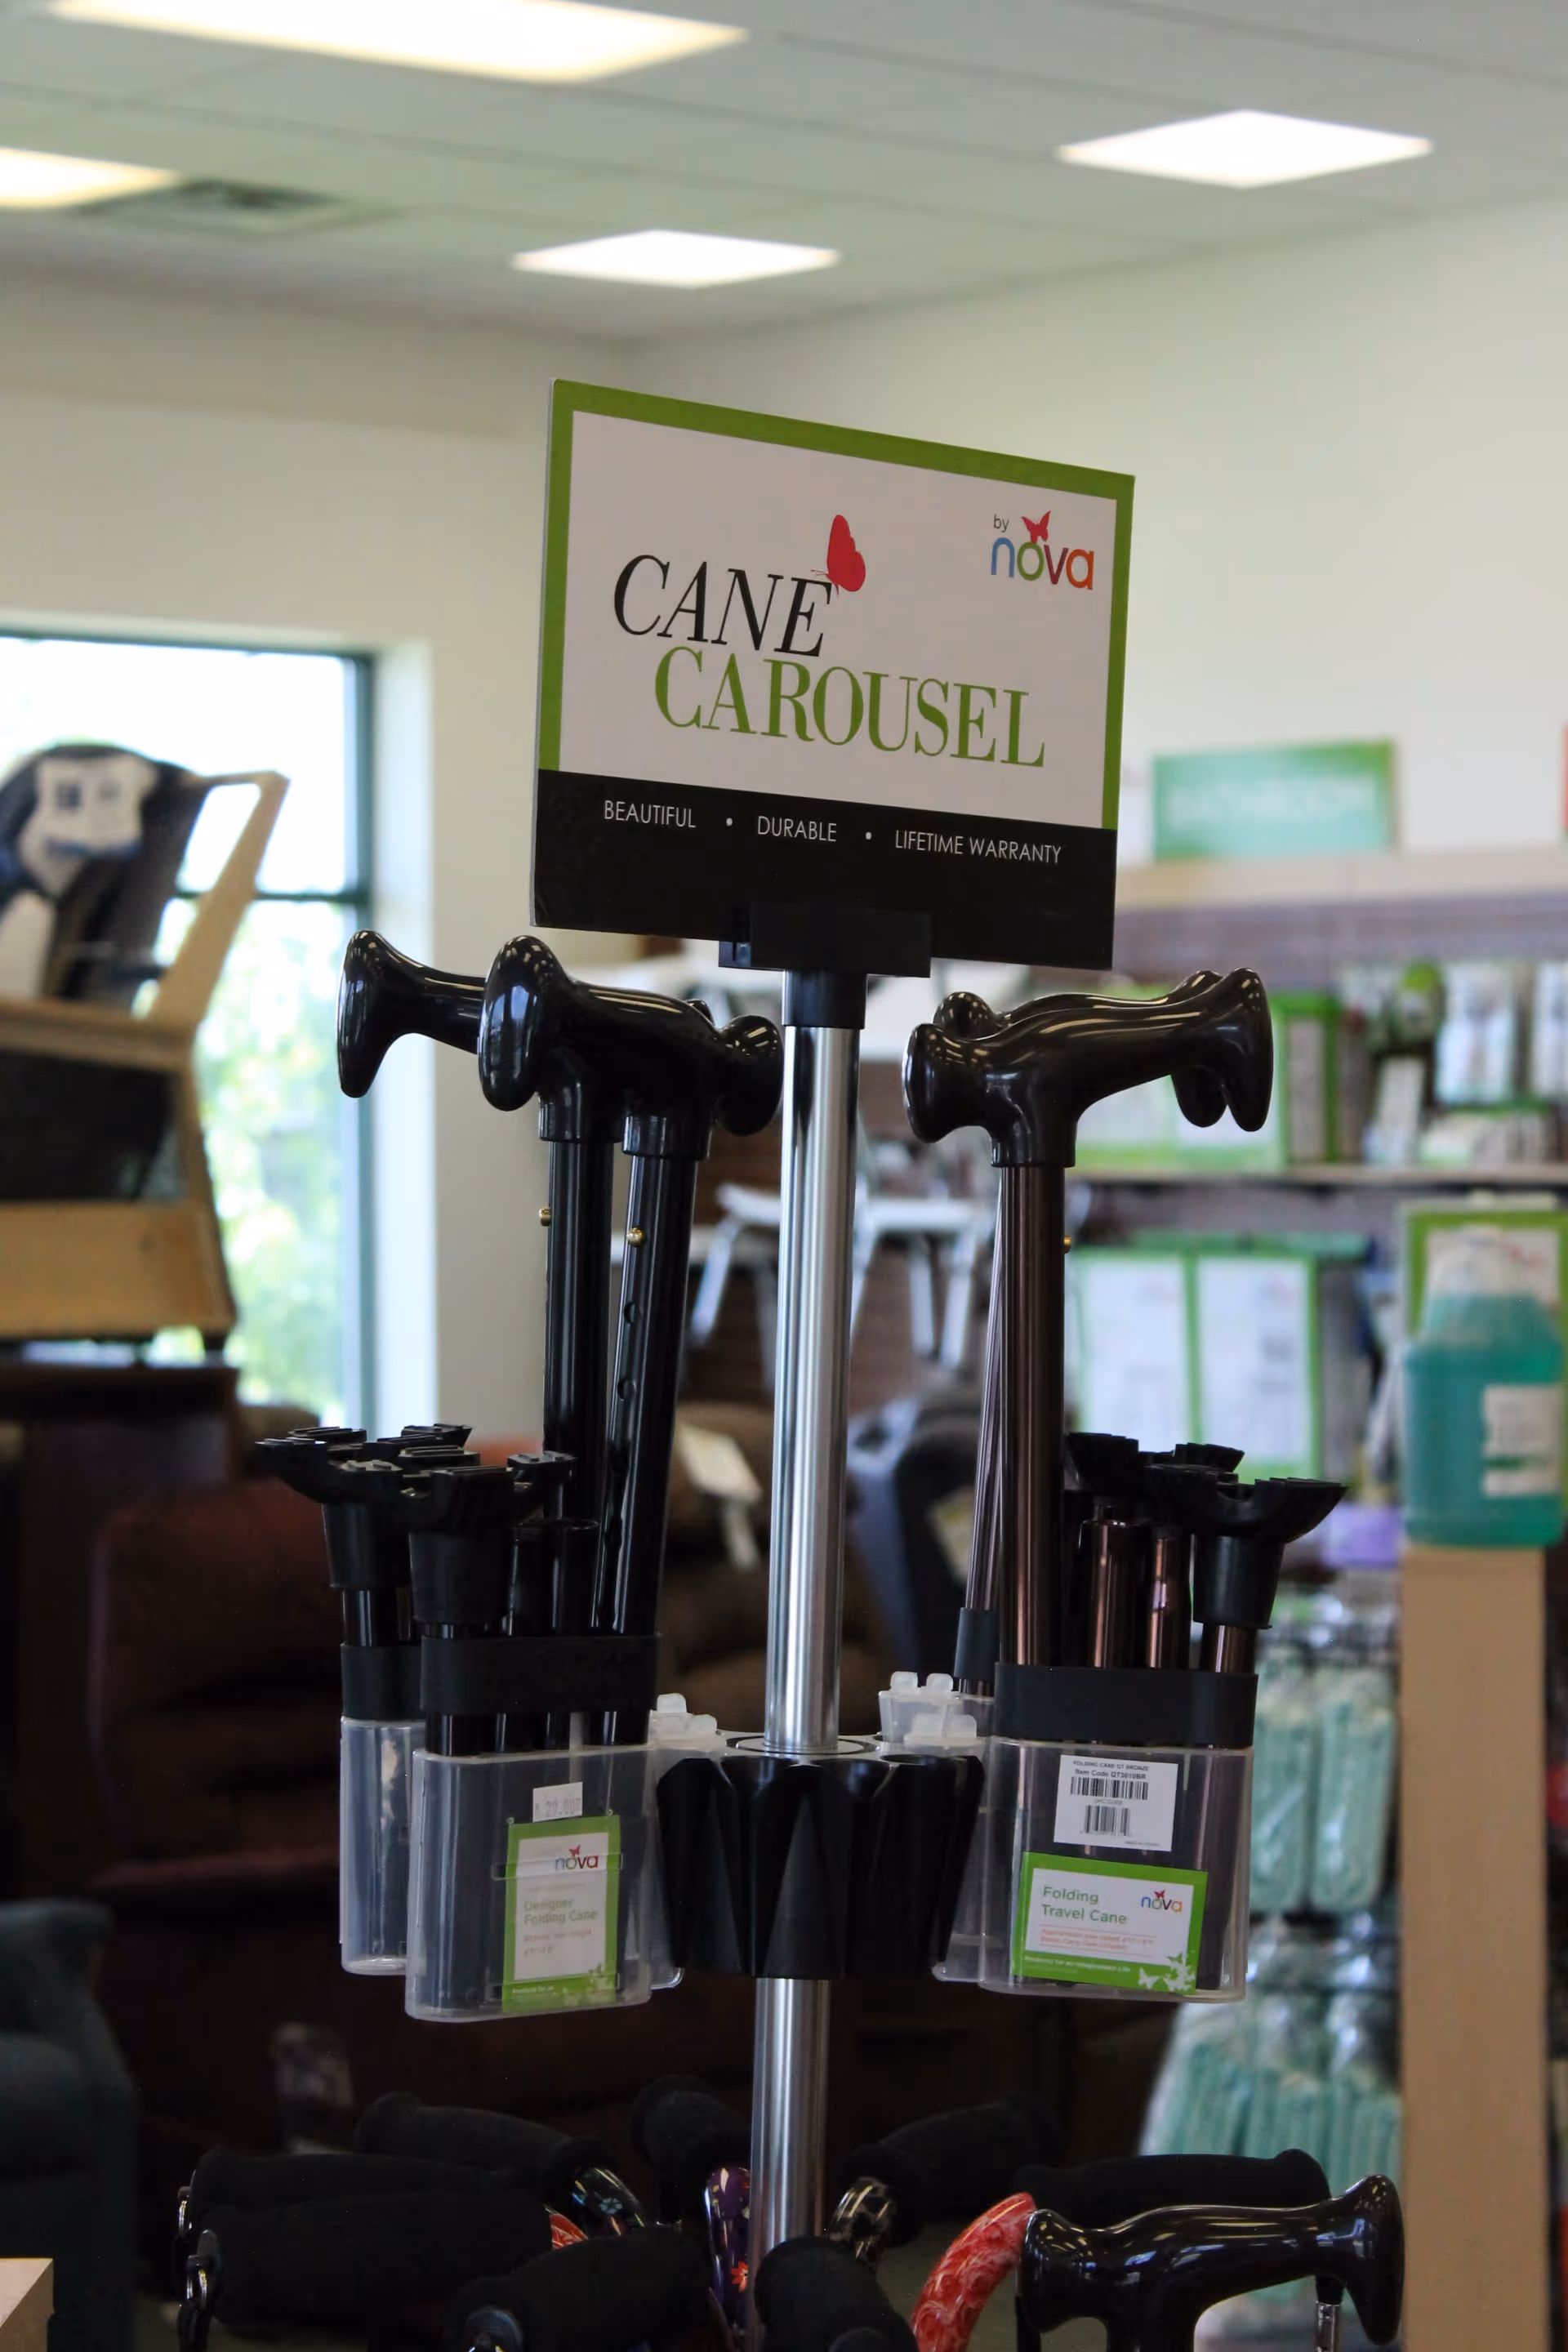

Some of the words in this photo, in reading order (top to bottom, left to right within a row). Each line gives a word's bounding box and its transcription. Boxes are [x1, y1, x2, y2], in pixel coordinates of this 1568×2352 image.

[993, 513, 1010, 533] by
[991, 537, 1095, 590] nova
[613, 554, 833, 657] CANE
[654, 645, 1045, 768] CAROUSEL
[604, 800, 697, 828] BEAUTIFUL
[757, 815, 837, 843] DURABLE
[895, 829, 964, 855] LIFETIME
[969, 835, 1062, 864] WARRANTY
[1091, 1769, 1109, 1777] Code
[555, 1855, 599, 1871] nova
[1043, 1886, 1099, 1905] Folding
[1141, 1895, 1183, 1913] nova
[523, 1913, 566, 1927] Folding
[568, 1909, 599, 1922] Cane
[1041, 1904, 1085, 1920] Travel
[1089, 1909, 1128, 1924] Cane
